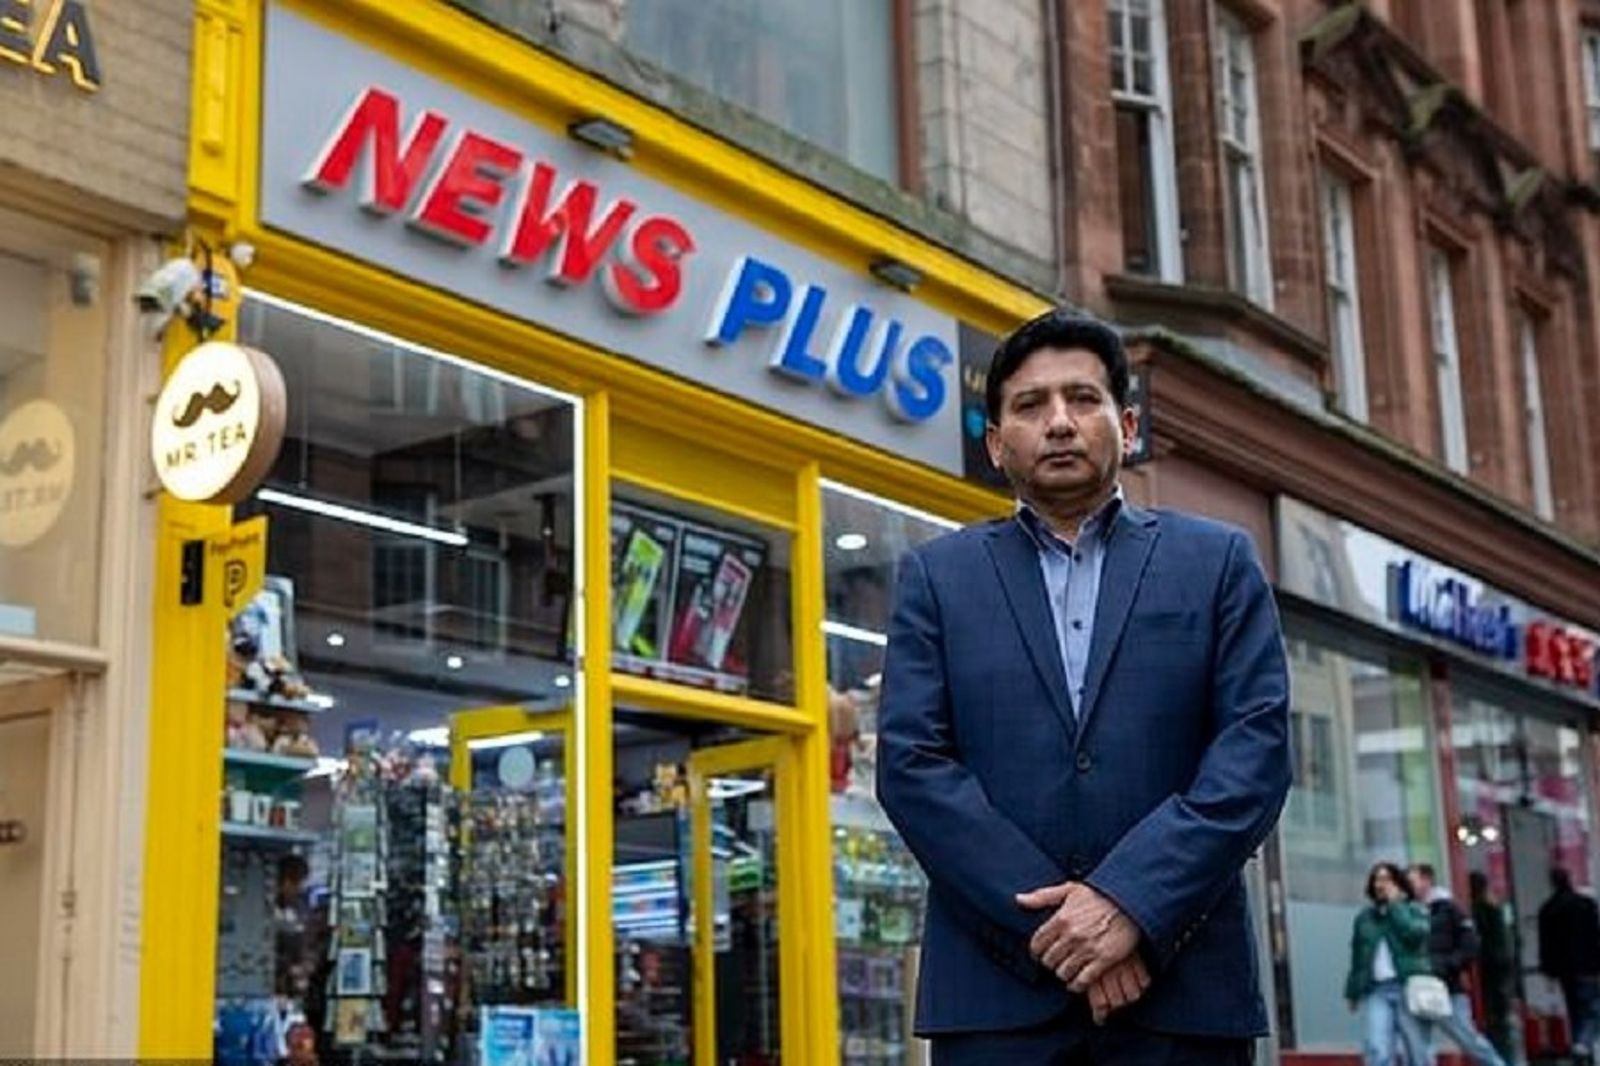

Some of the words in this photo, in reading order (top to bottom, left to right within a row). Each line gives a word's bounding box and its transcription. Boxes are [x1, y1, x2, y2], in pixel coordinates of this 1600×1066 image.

[303, 87, 698, 316] NEWS
[706, 257, 955, 424] PLUS
[166, 443, 196, 468] MR
[207, 422, 247, 455] TEA
